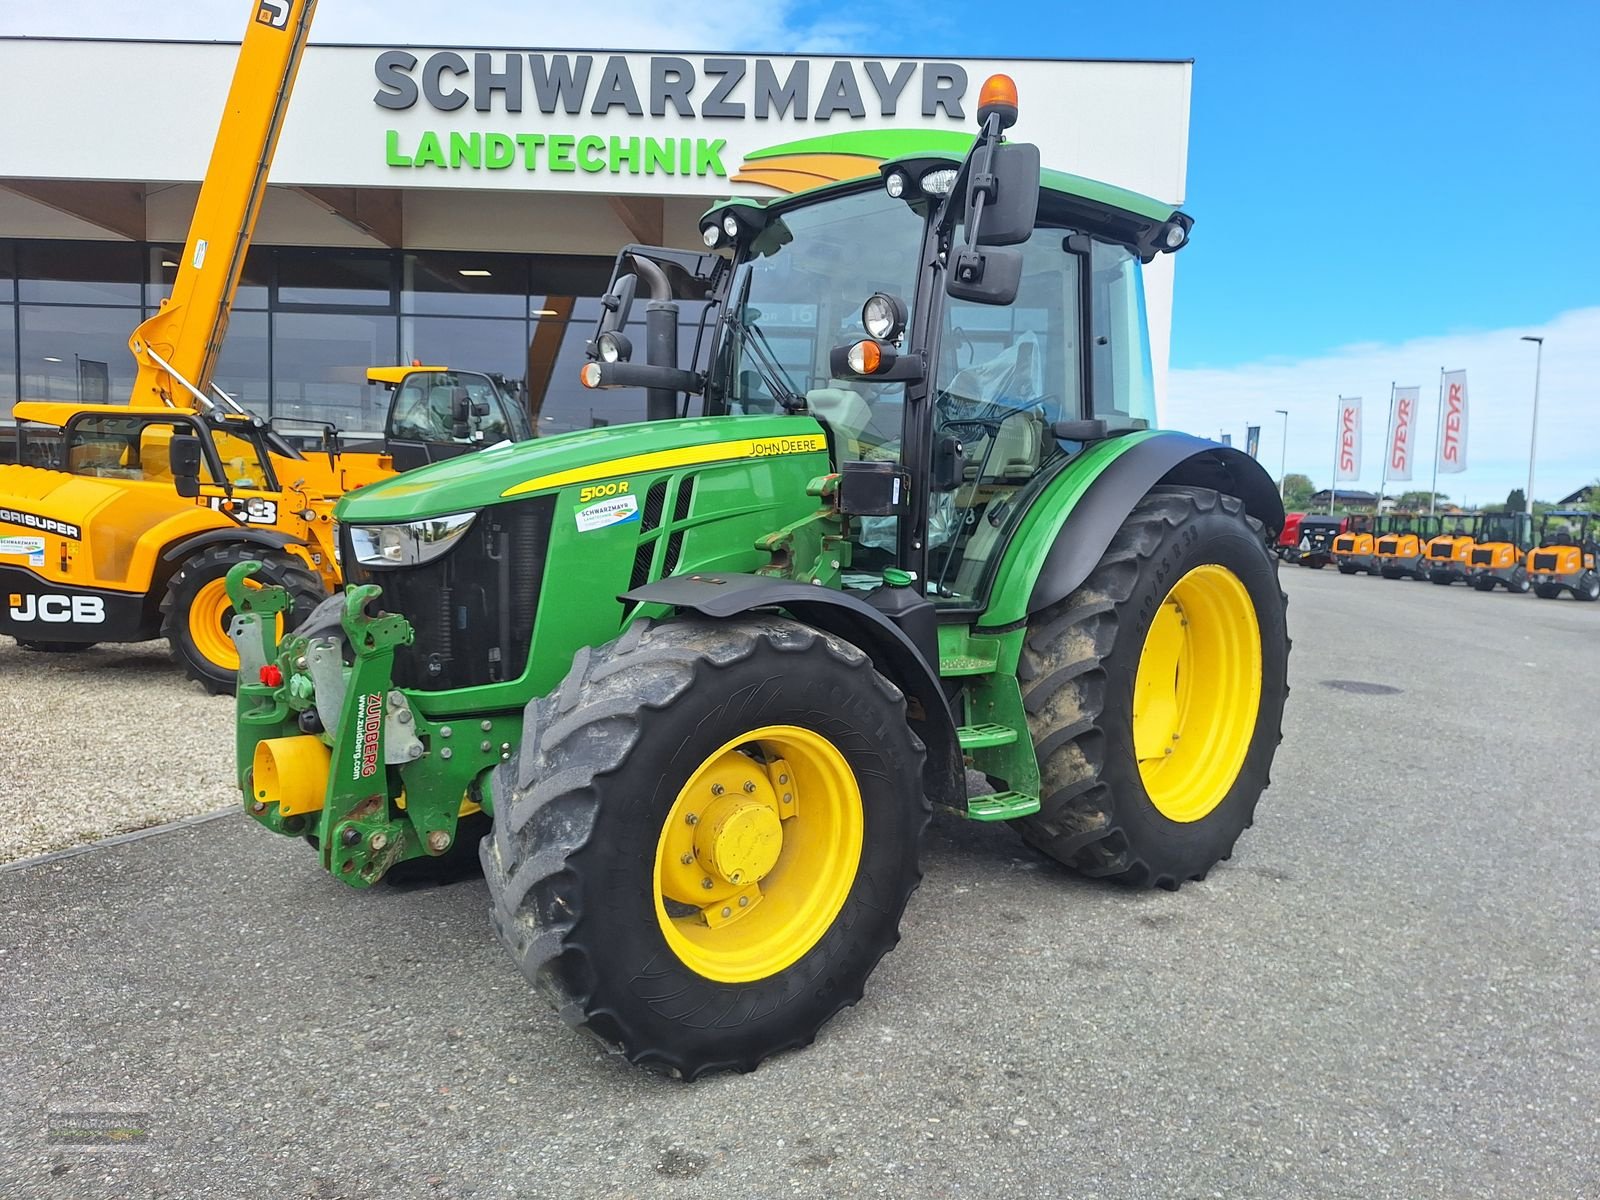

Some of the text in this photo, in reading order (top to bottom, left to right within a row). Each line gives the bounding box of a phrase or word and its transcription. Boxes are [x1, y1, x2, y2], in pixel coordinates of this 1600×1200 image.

[374, 51, 968, 121] SCHWARZMAYR
[386, 130, 727, 176] LANDTECHNIK
[750, 440, 817, 455] JOHN DEERE
[1340, 408, 1354, 472] STEYR
[1392, 399, 1410, 472] STEYR
[1444, 383, 1461, 463] STEYR
[581, 503, 629, 517] SCHWARZMAYR
[10, 594, 105, 623] JCB
[352, 694, 366, 780] www.zuidberg.com
[361, 692, 382, 777] ZUIDBERG
